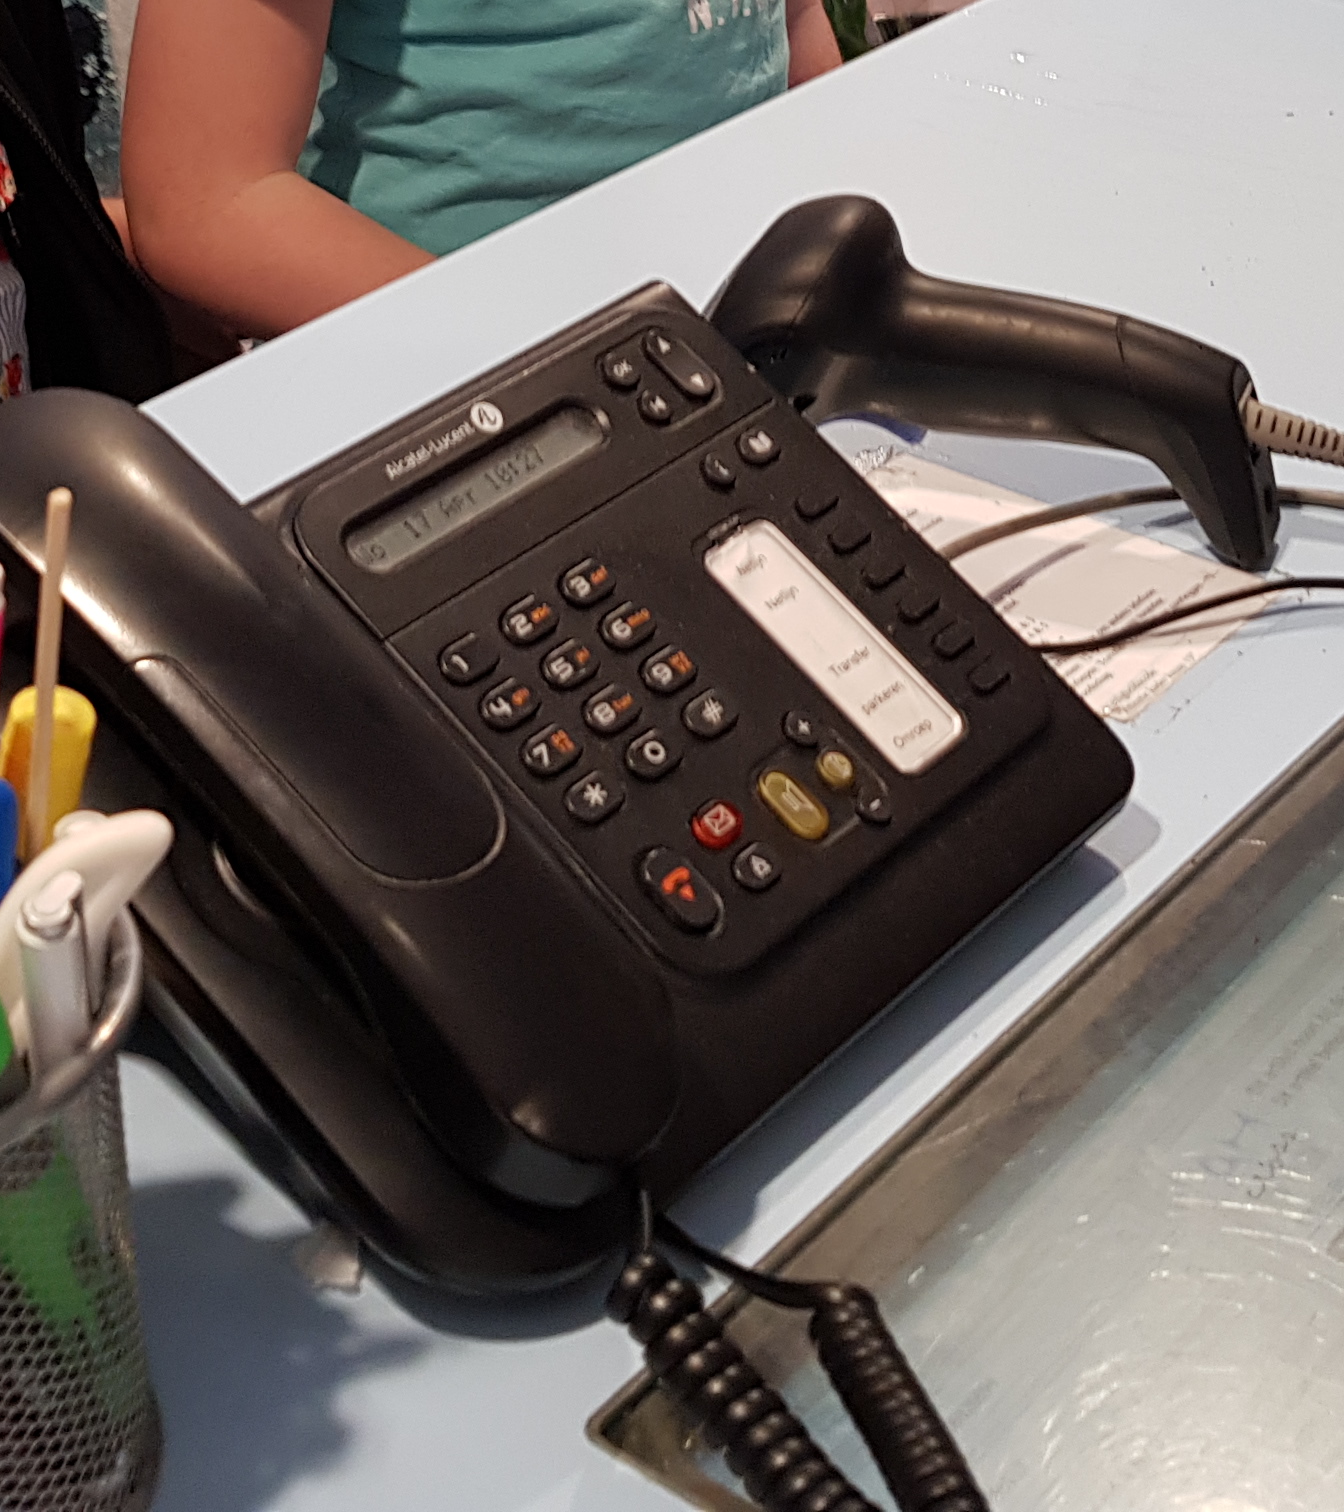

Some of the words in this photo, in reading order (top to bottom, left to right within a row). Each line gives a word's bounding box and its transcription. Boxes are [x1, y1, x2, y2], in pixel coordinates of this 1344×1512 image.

[384, 420, 476, 481] Alcatel-Lucent
[403, 509, 432, 539] 17
[569, 575, 591, 597] 3
[509, 613, 533, 636] 2
[611, 617, 632, 639] 6
[451, 654, 469, 674] 1
[550, 656, 573, 681] 5
[651, 661, 673, 685] 9
[488, 696, 513, 718] 4
[593, 701, 616, 726] 8
[532, 742, 550, 768] 7
